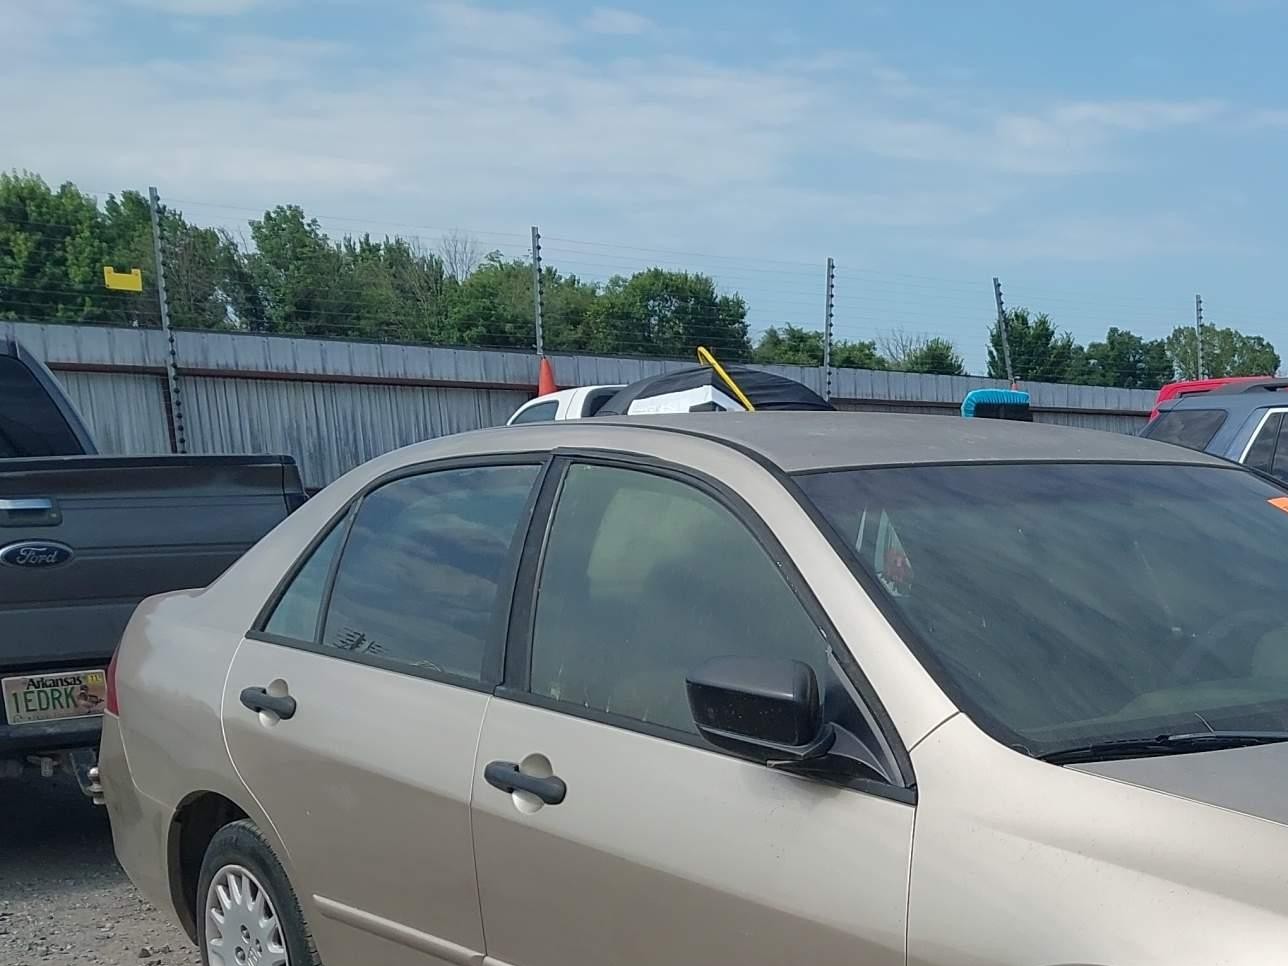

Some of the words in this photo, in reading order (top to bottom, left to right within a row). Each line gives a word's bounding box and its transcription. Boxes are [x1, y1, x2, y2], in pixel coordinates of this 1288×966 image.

[16, 547, 59, 564] Ford
[26, 675, 82, 690] Arkansas
[12, 686, 79, 714] 1EDRK
